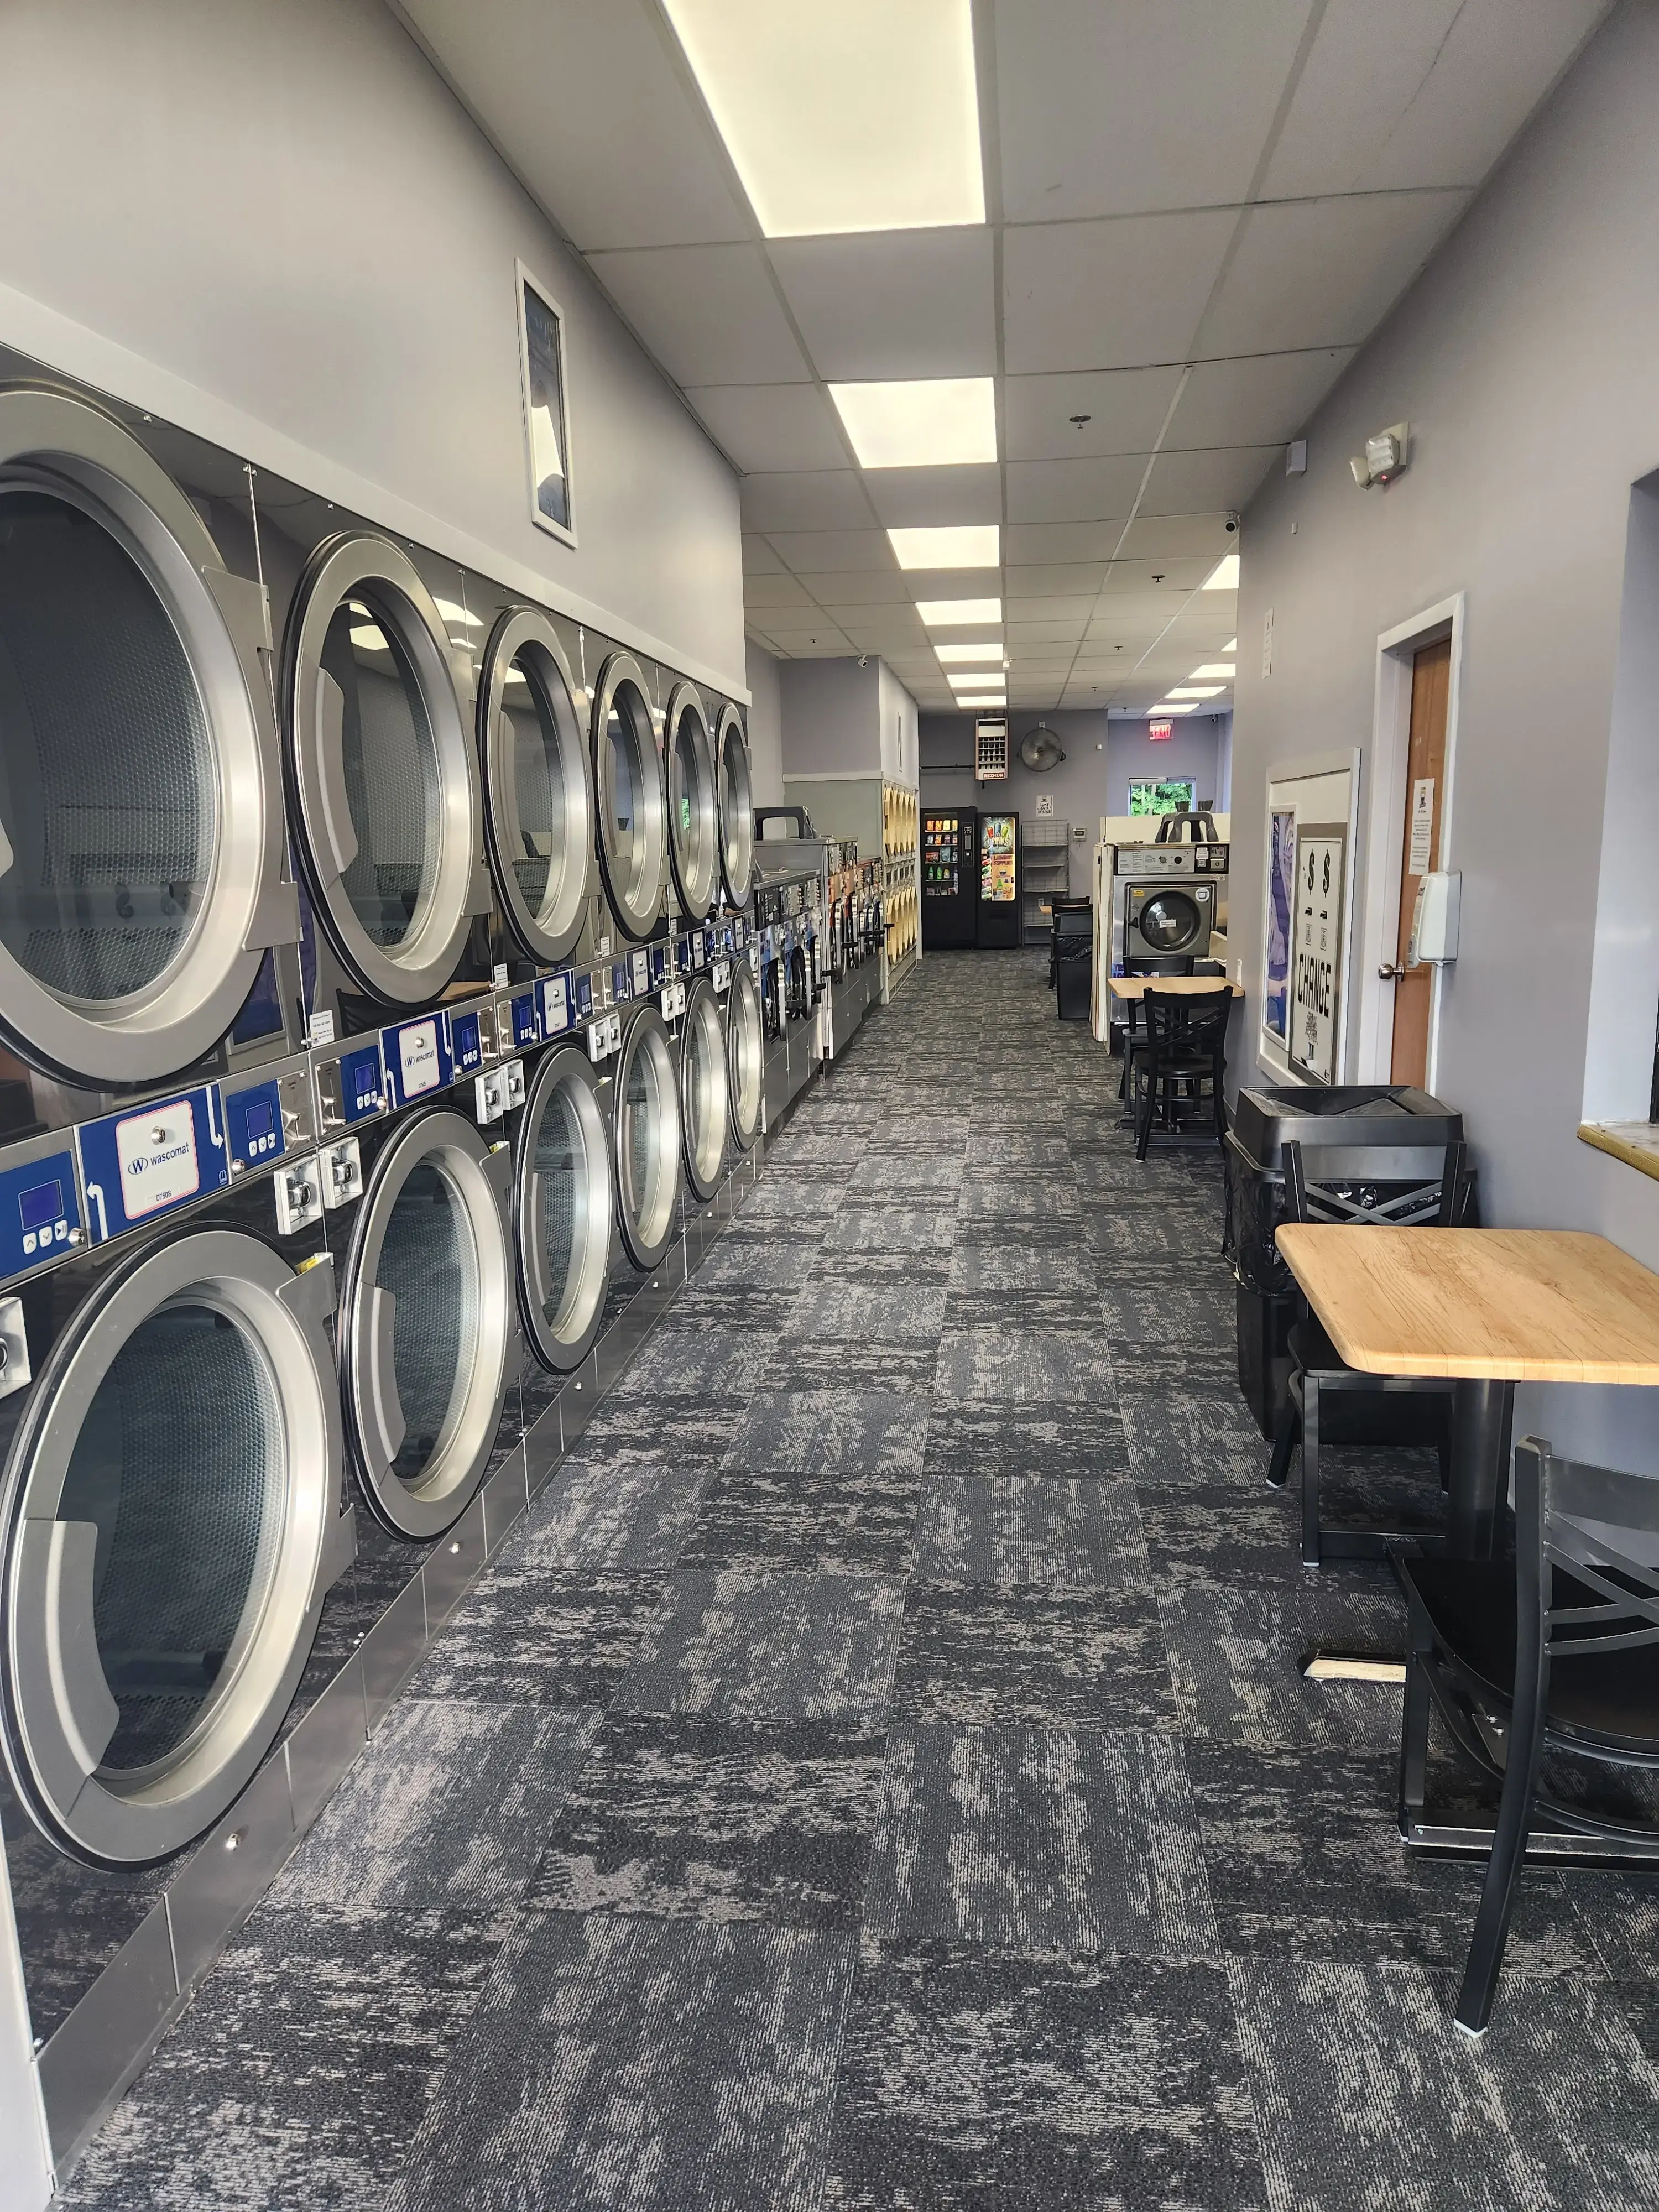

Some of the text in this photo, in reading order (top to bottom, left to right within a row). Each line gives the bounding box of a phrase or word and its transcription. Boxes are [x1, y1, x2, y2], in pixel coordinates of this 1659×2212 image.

[1154, 726, 1170, 737] EXIT
[988, 836, 1008, 846] DRINKS
[1298, 953, 1331, 1018] CHANGE
[150, 1142, 189, 1166] wascomat
[156, 1190, 171, 1201] D750S
